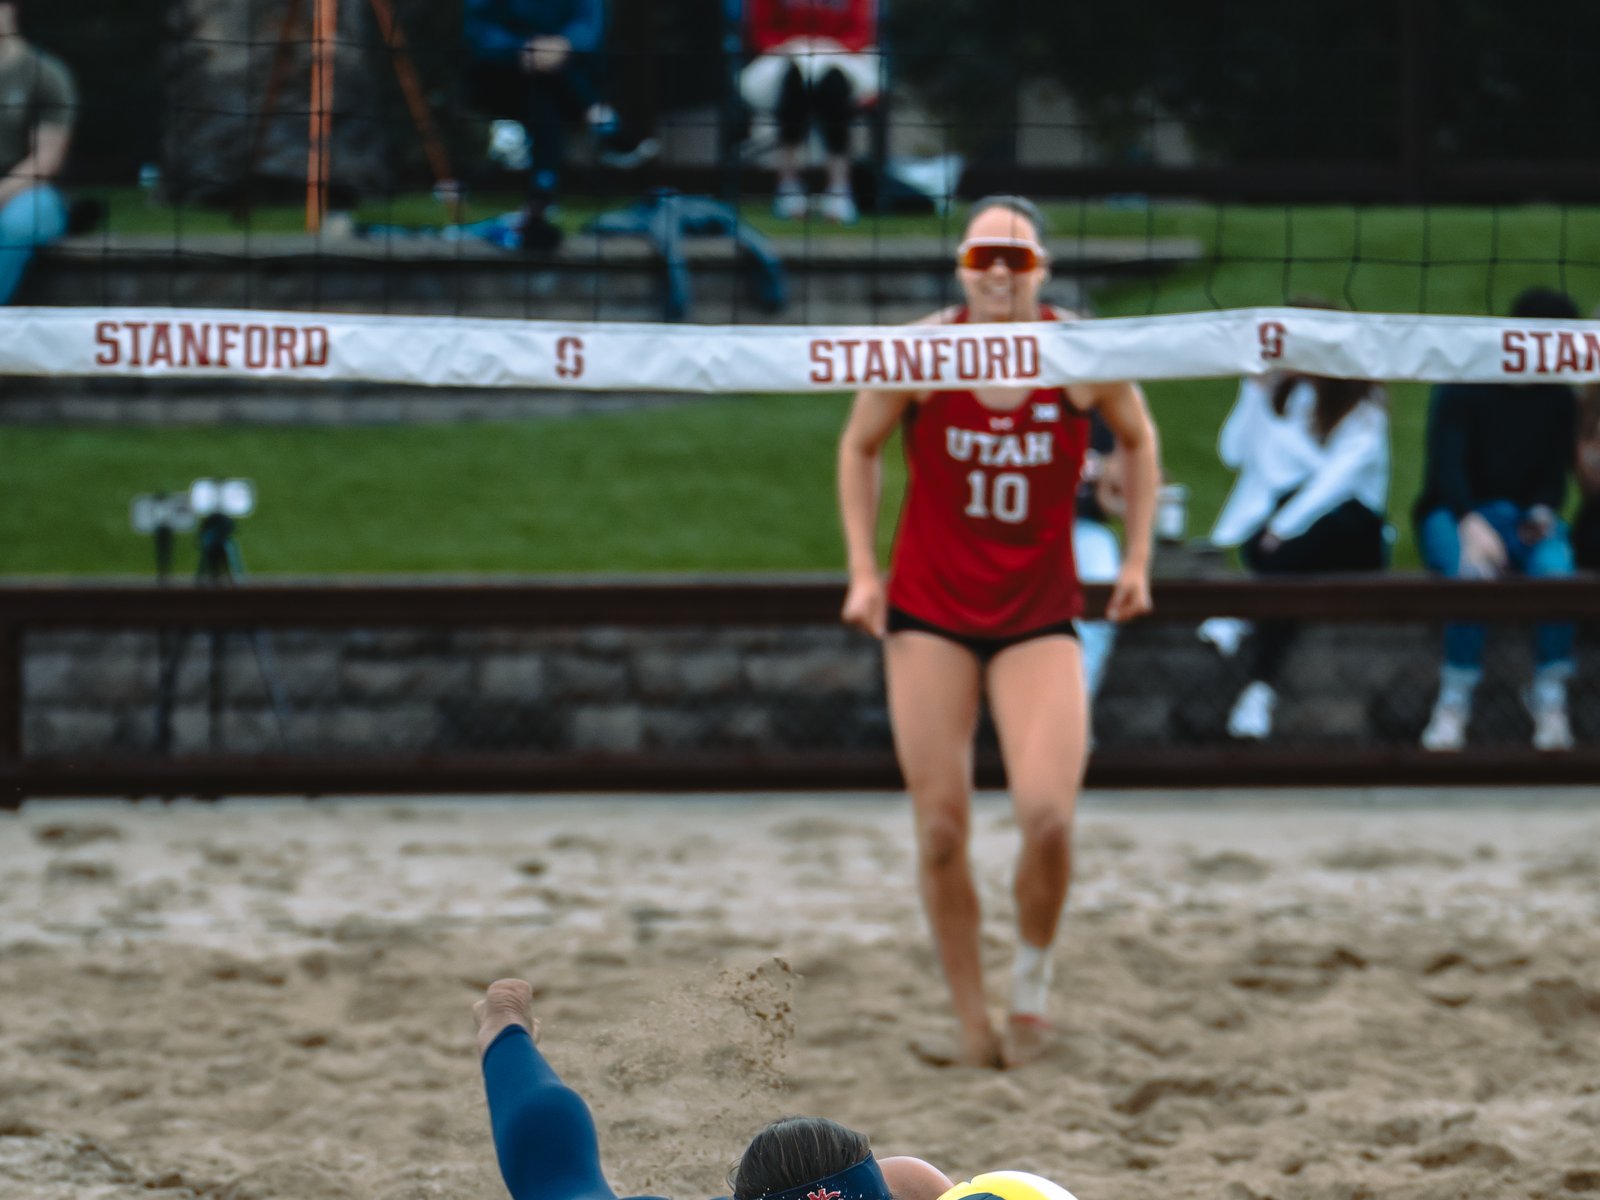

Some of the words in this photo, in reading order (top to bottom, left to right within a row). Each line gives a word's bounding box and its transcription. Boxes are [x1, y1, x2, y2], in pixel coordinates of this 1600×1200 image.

[95, 321, 329, 369] STANFORD
[809, 335, 1041, 383] STANFORD
[946, 426, 1053, 467] UTAH
[964, 469, 1029, 523] 10
